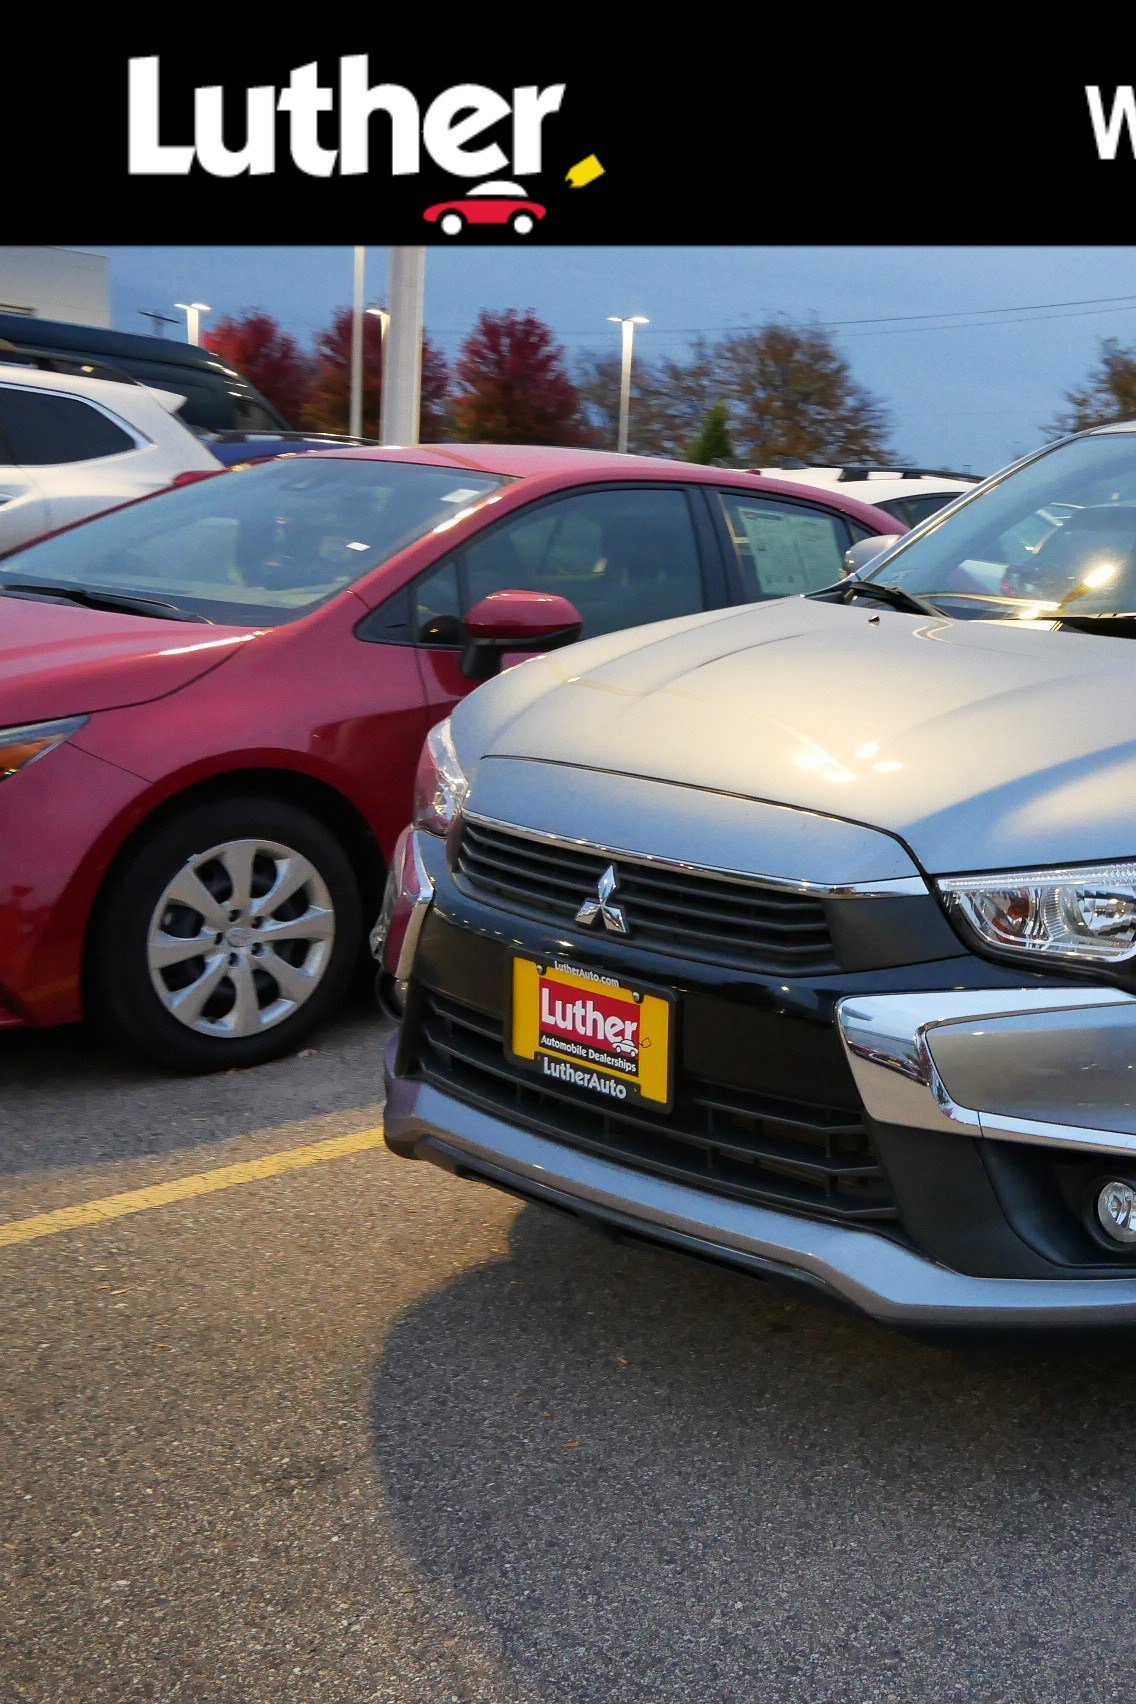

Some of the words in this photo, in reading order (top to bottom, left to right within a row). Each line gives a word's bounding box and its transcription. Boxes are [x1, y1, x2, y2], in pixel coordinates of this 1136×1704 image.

[554, 960, 620, 988] LutherAuto.com
[541, 987, 639, 1044] Luther
[541, 1034, 588, 1058] Automobile
[588, 1048, 637, 1072] Dealerships
[543, 1056, 627, 1099] LutherAuto
